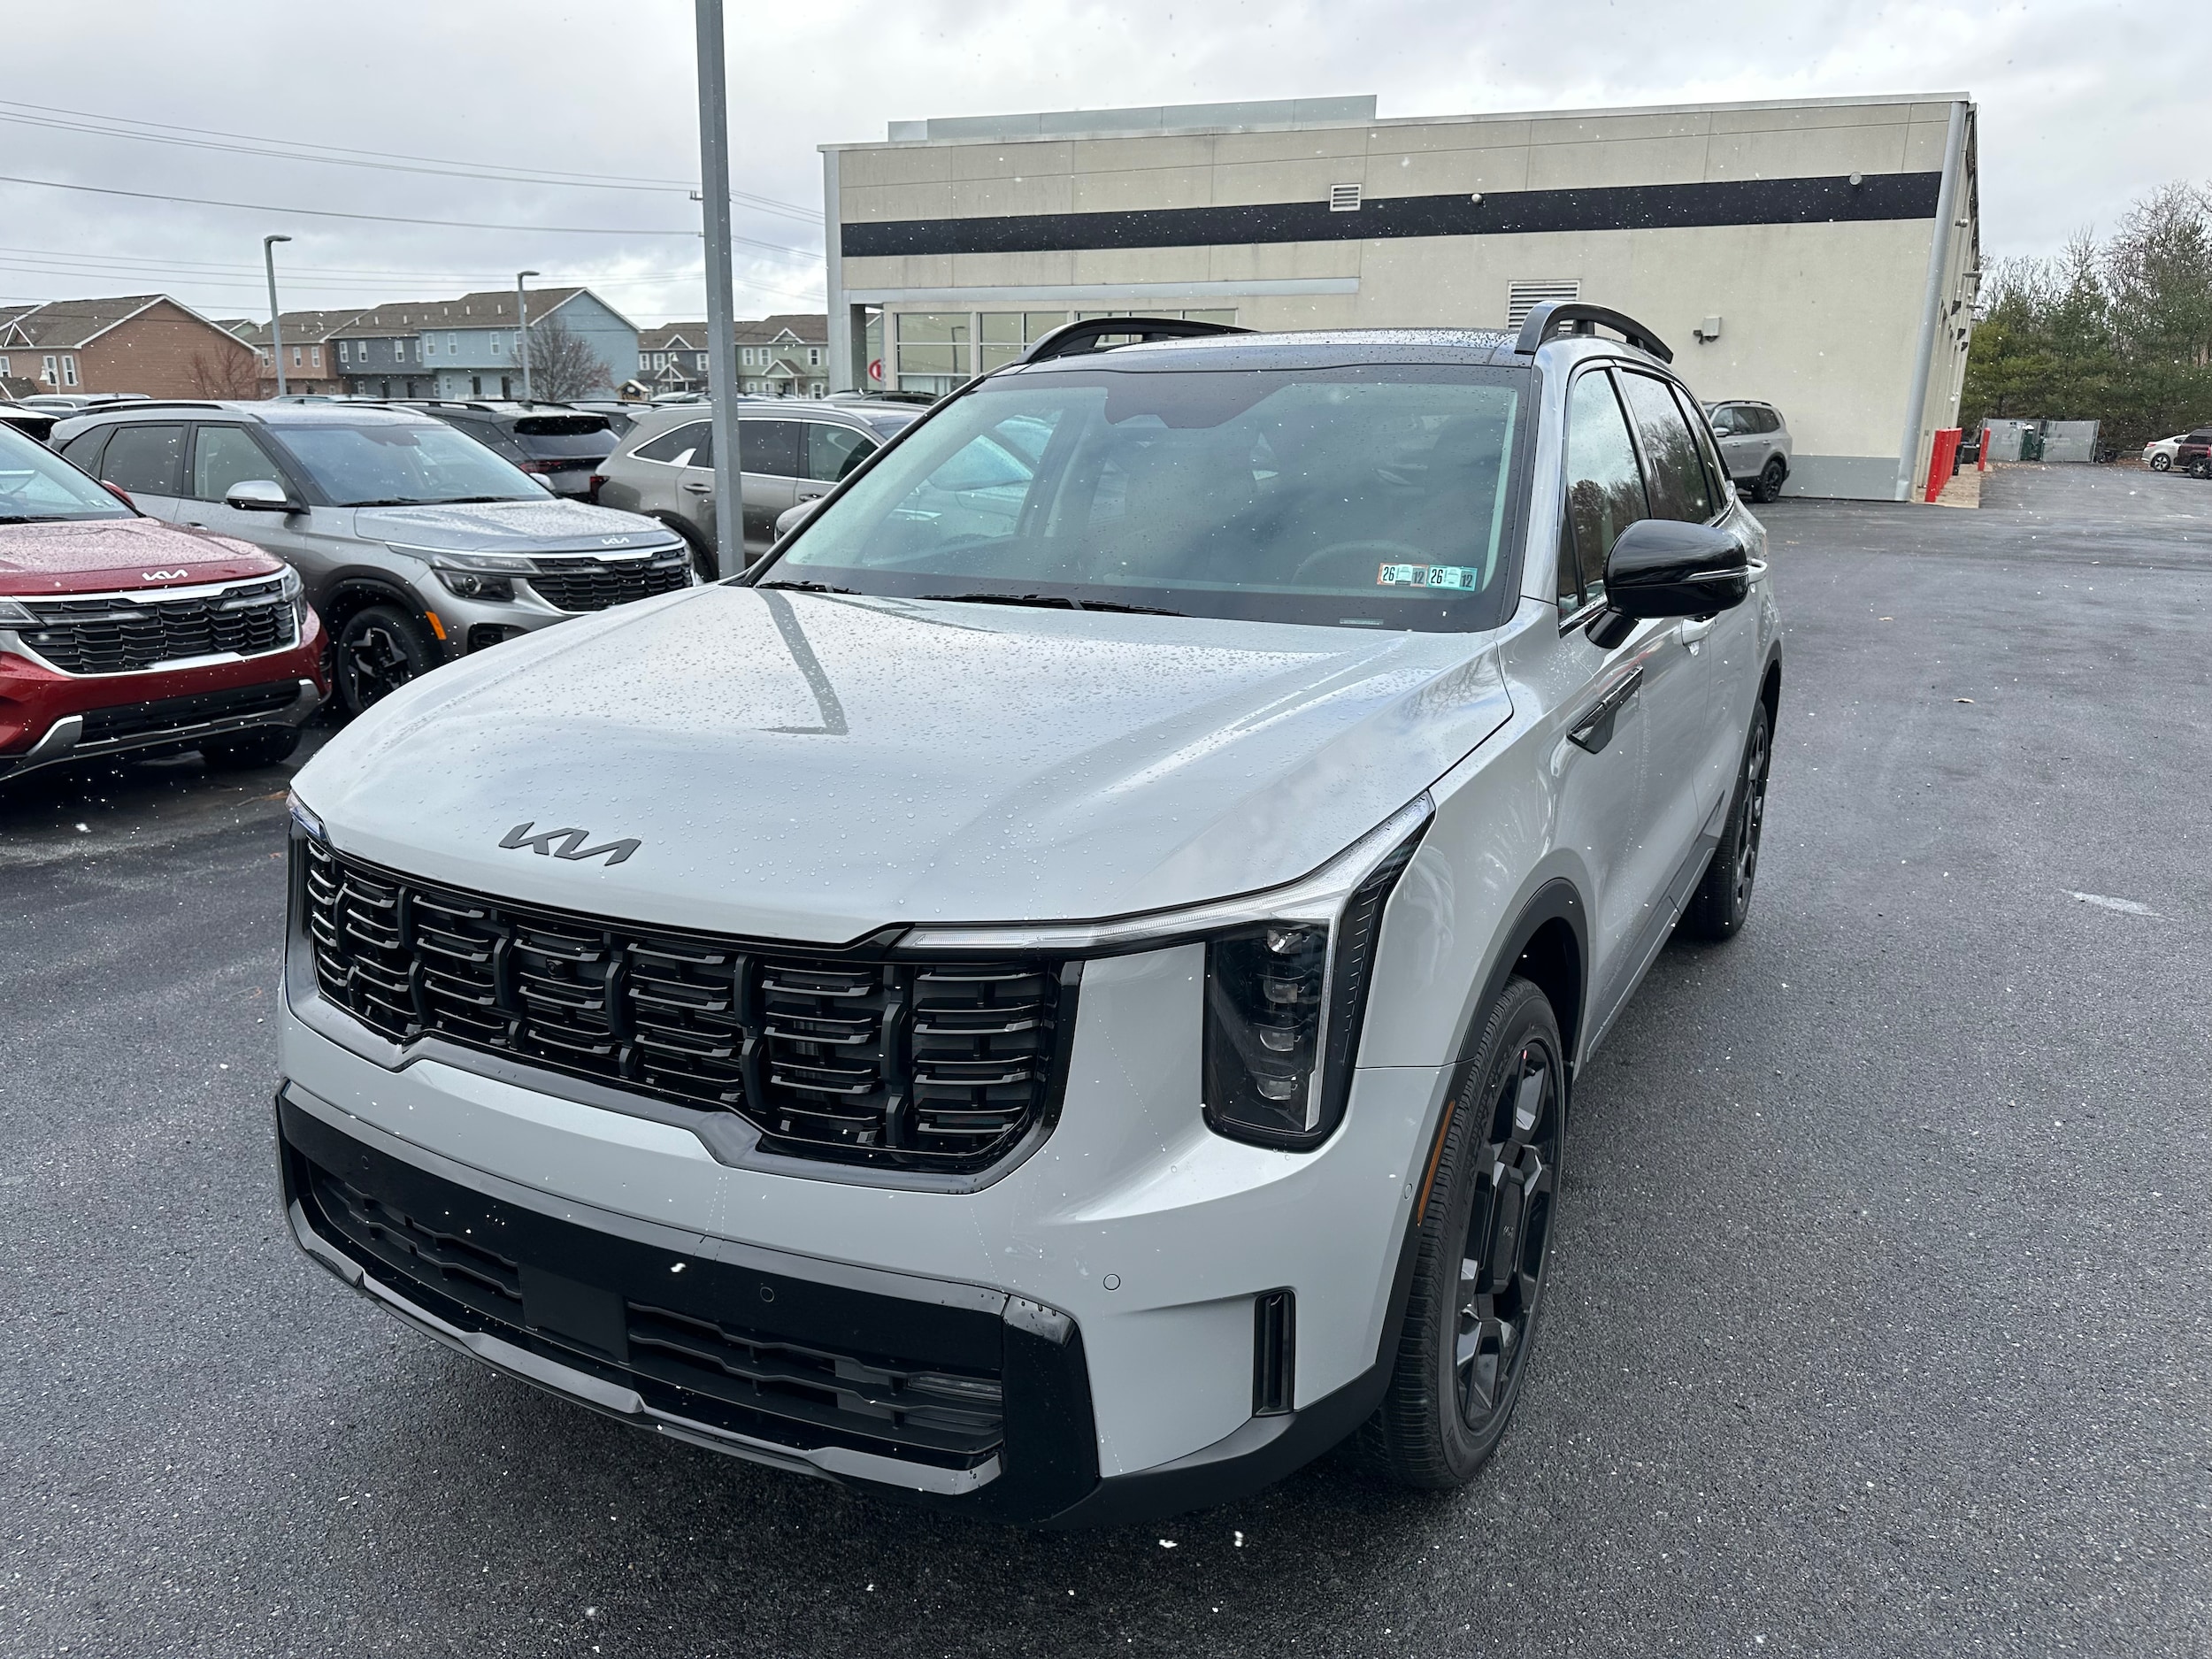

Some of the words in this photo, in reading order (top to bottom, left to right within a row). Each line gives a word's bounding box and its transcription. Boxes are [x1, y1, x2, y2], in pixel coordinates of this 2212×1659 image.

[602, 536, 630, 545] KIA
[142, 569, 188, 581] KIA
[1382, 566, 1395, 581] 26
[1412, 571, 1425, 584] 12
[1430, 568, 1444, 584] 26
[1461, 573, 1473, 588] 12
[498, 821, 642, 867] KIA
